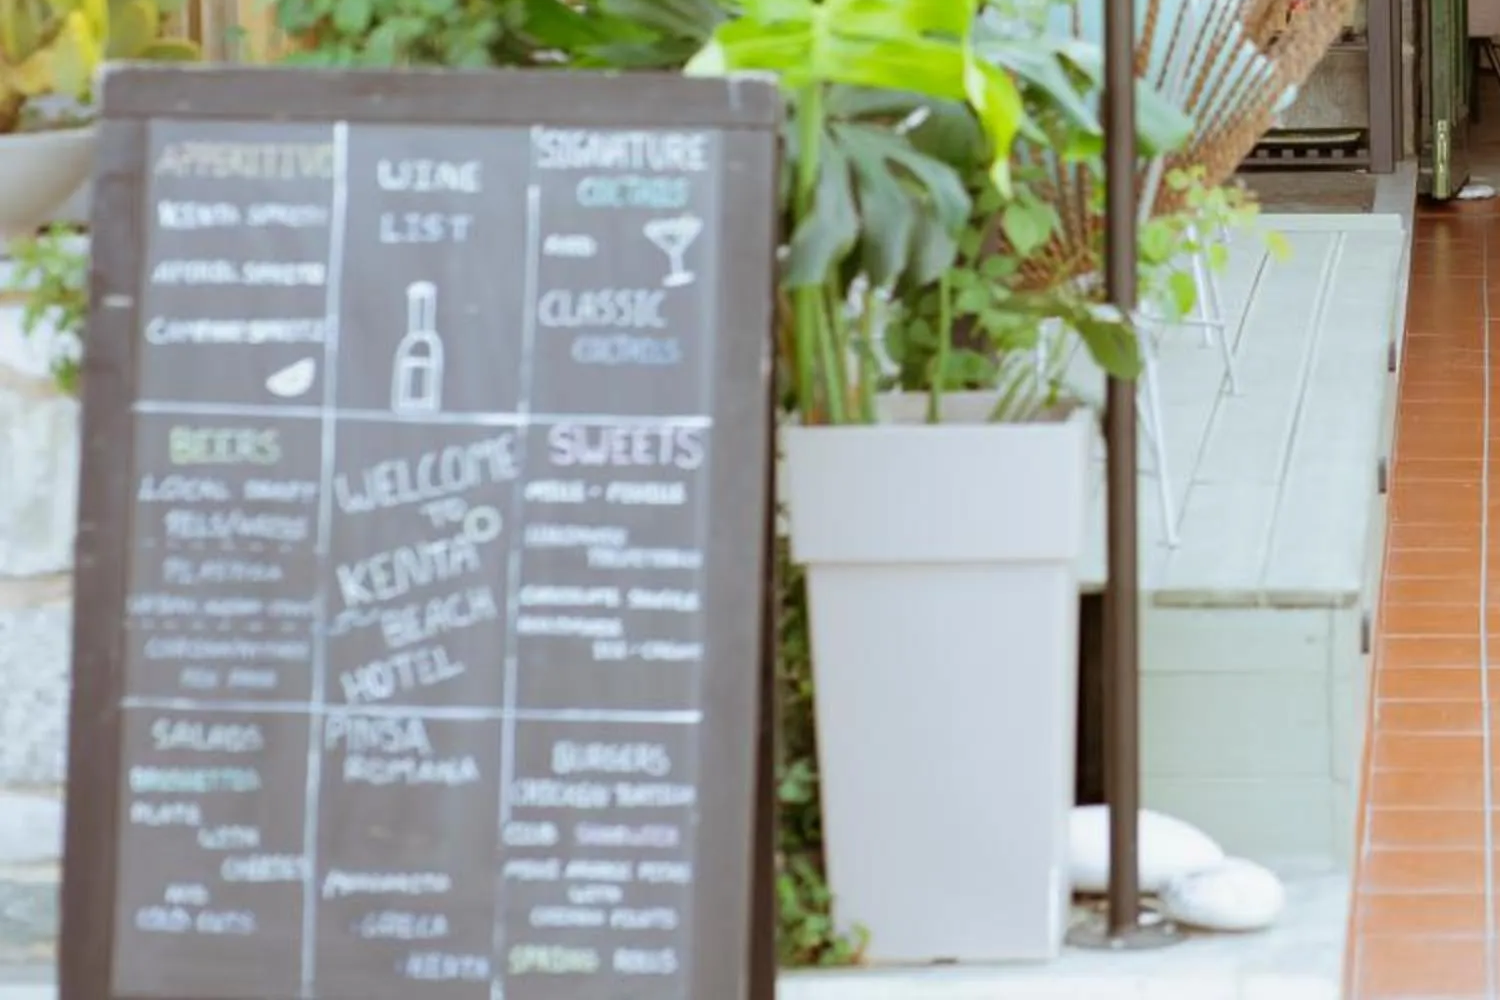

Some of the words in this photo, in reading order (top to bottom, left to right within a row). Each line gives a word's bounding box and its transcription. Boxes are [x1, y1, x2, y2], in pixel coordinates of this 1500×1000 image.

[533, 129, 710, 172] SIGNATURE
[377, 158, 483, 192] WINE
[380, 213, 474, 243] LIST
[538, 288, 668, 328] CLASSIC
[168, 425, 282, 465] BEERS
[548, 422, 706, 470] SWEETS
[333, 431, 526, 513] WELCOME
[336, 534, 480, 605] KENTA
[380, 584, 498, 648] BEACH
[339, 644, 465, 703] HOTEL
